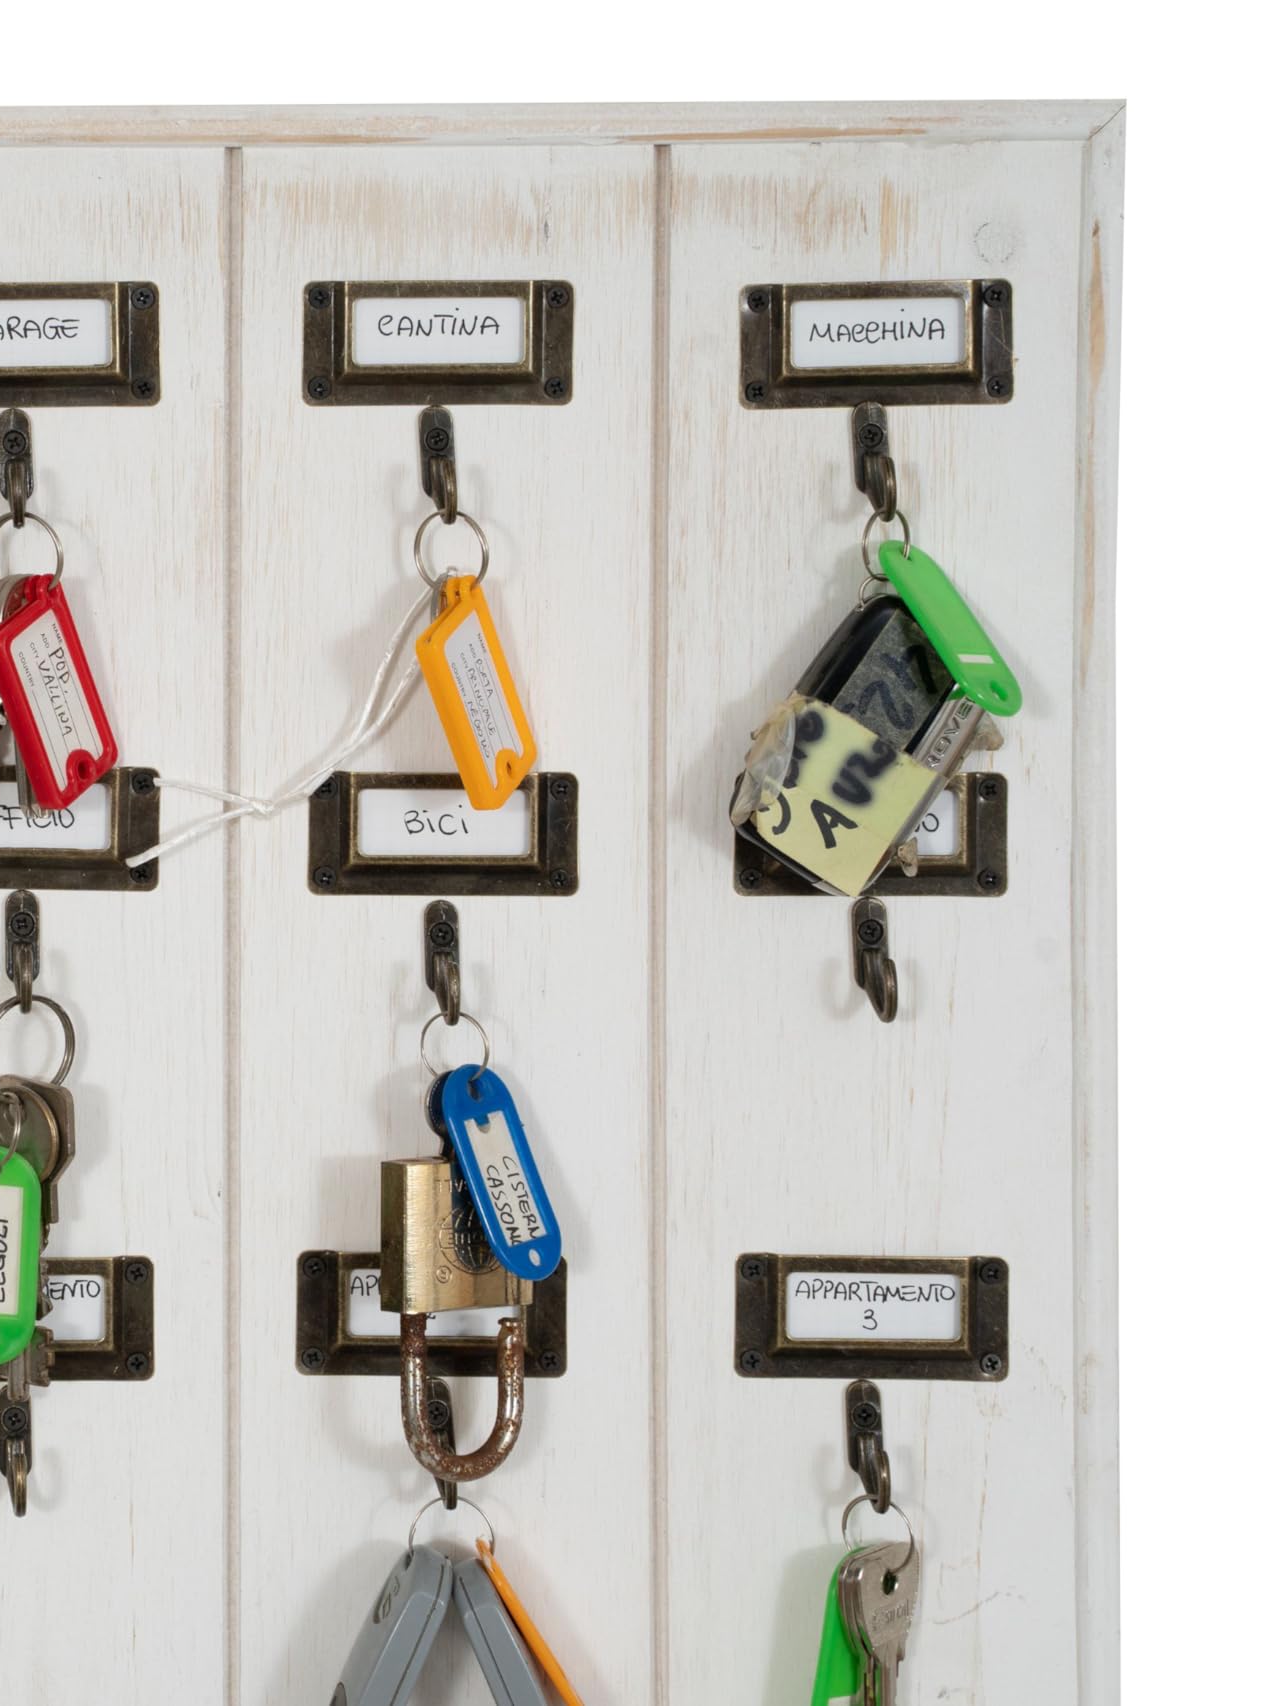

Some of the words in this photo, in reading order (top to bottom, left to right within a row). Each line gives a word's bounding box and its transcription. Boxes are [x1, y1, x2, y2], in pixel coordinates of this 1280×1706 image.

[378, 307, 500, 337] CANTINA
[809, 308, 945, 344] MACCHINA
[40, 633, 50, 649] ADD
[52, 623, 63, 645] NAME
[29, 642, 40, 658] CITY
[19, 652, 35, 687] COUNTRY
[486, 1165, 522, 1245] CASSON
[795, 1278, 956, 1303] APPARTAMENTO
[862, 1309, 878, 1330] 3
